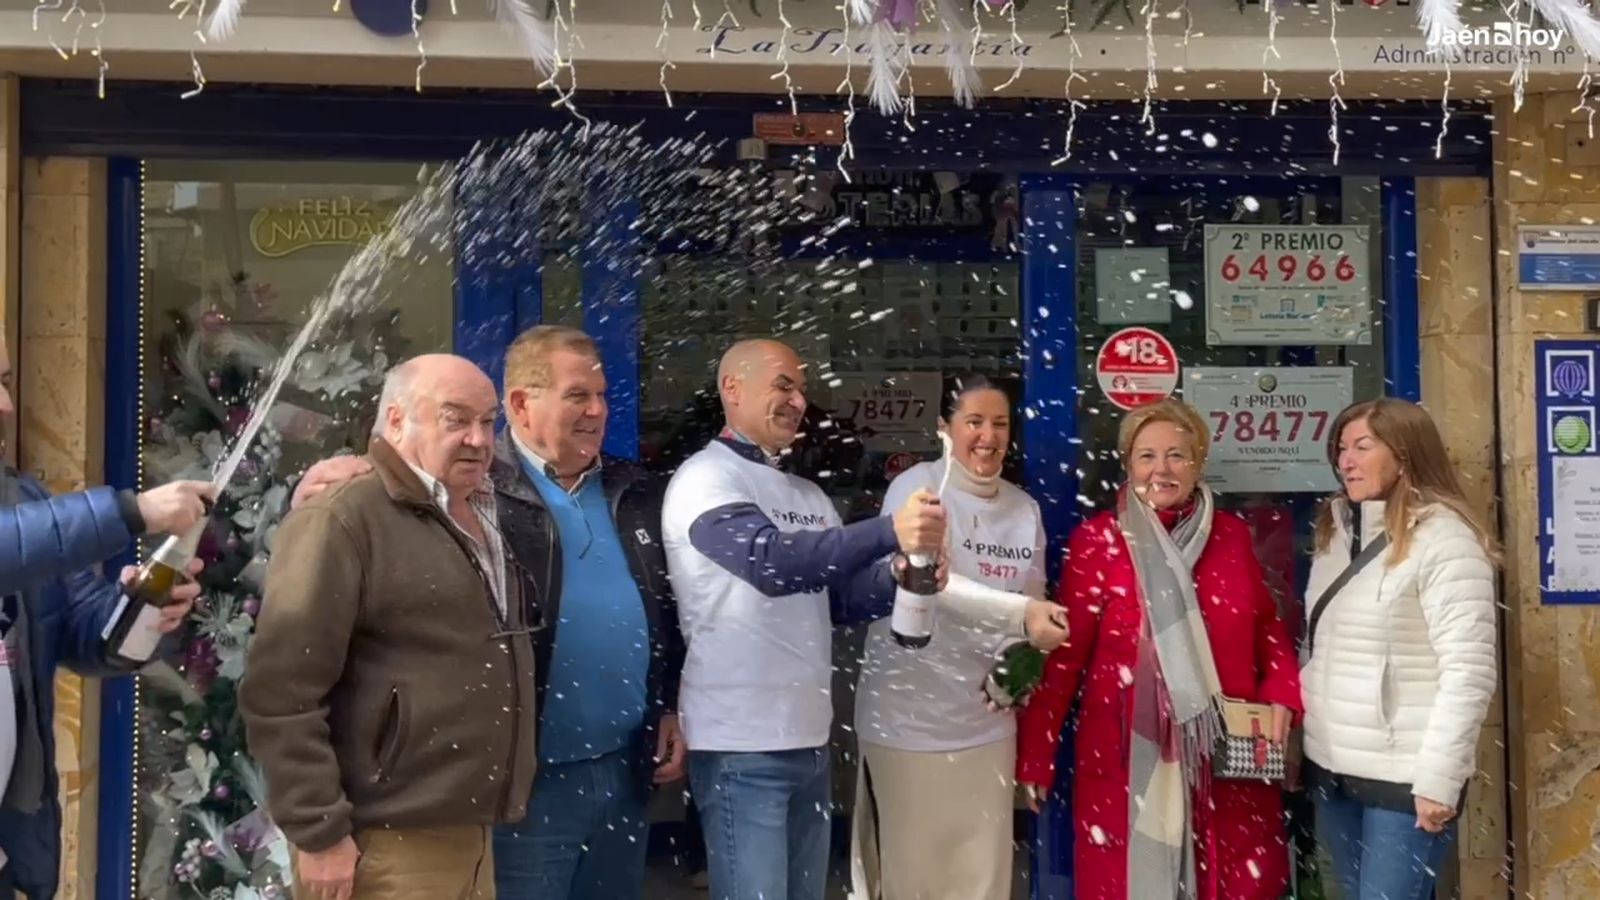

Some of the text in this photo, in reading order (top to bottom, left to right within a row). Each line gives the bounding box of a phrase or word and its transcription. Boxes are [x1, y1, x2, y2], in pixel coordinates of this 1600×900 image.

[696, 26, 774, 53] La
[300, 196, 371, 217] FELIZ
[1261, 232, 1344, 250] PREMIO
[1220, 254, 1355, 282] 64966
[848, 399, 926, 420] 78477
[1247, 394, 1307, 409] PREMIO
[1209, 410, 1328, 442] 78477
[976, 543, 1032, 559] PREMIO
[978, 561, 1017, 579] 78477
